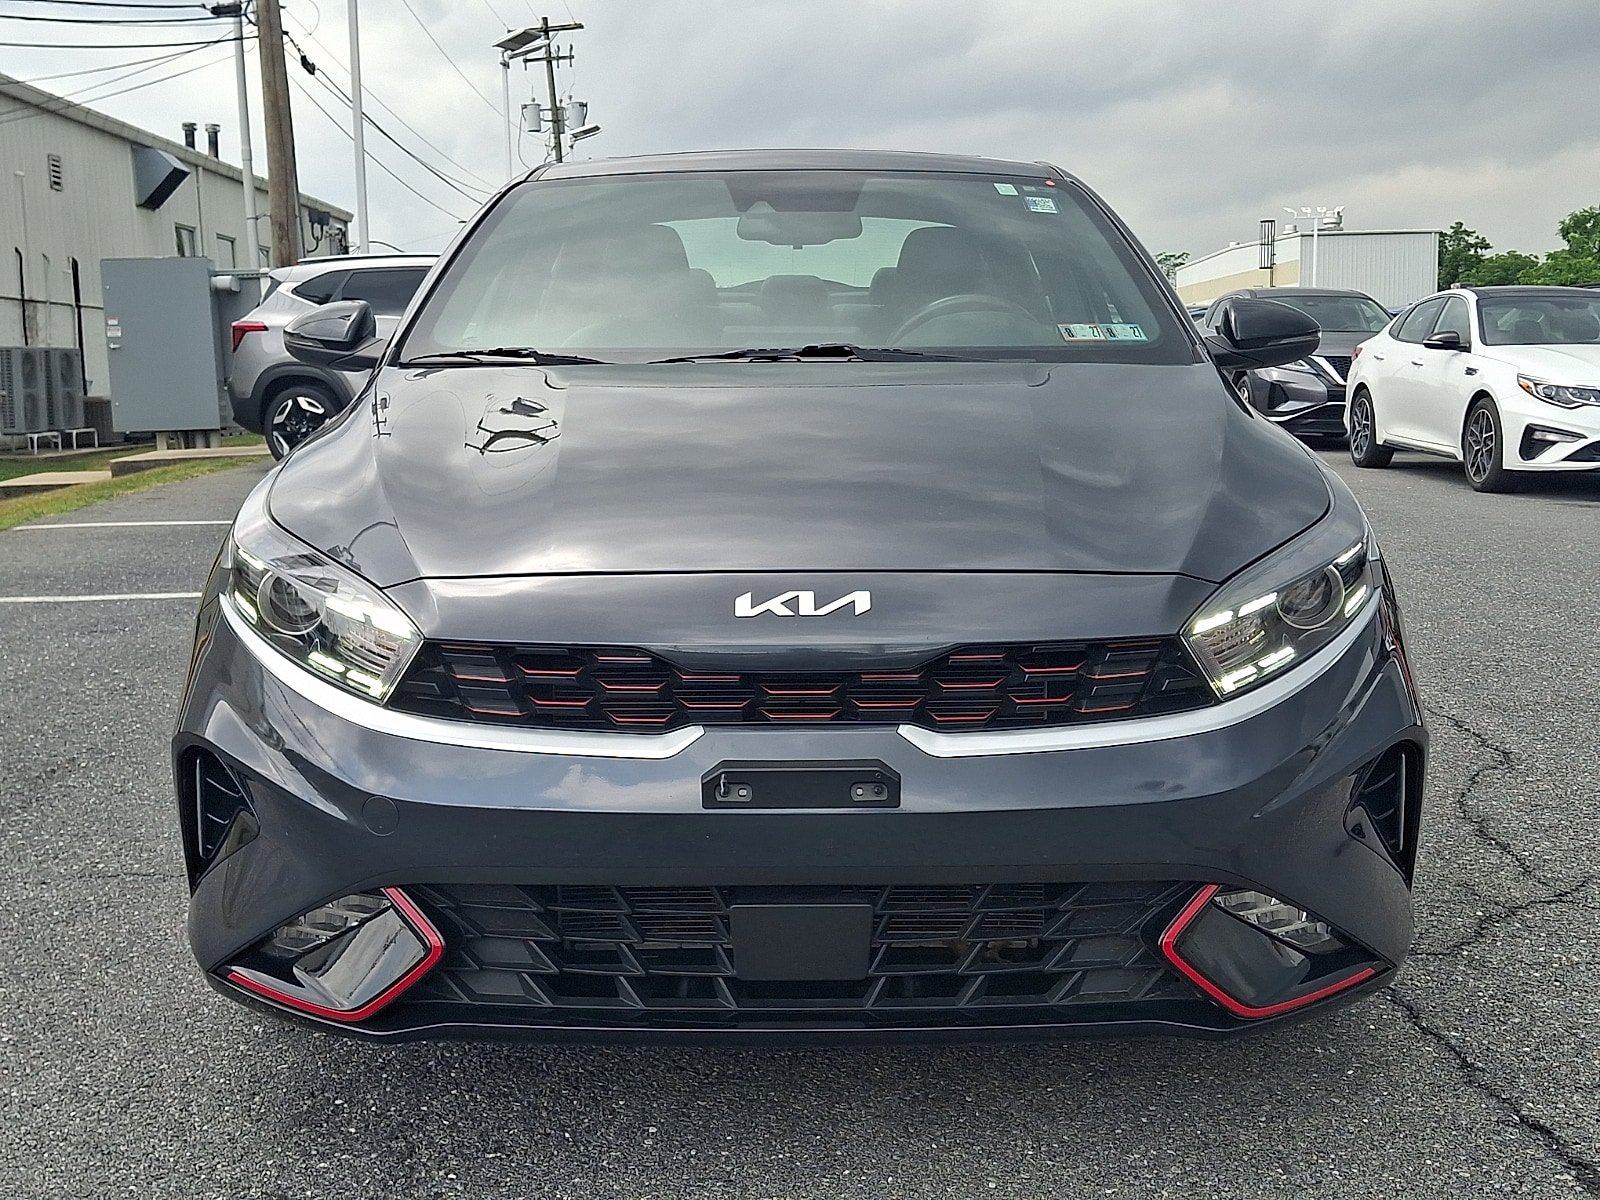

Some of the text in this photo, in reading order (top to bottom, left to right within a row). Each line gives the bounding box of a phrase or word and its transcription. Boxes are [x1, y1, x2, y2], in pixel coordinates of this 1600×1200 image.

[1089, 325, 1101, 338] 27
[1129, 326, 1142, 338] 27
[734, 590, 871, 617] KIA
